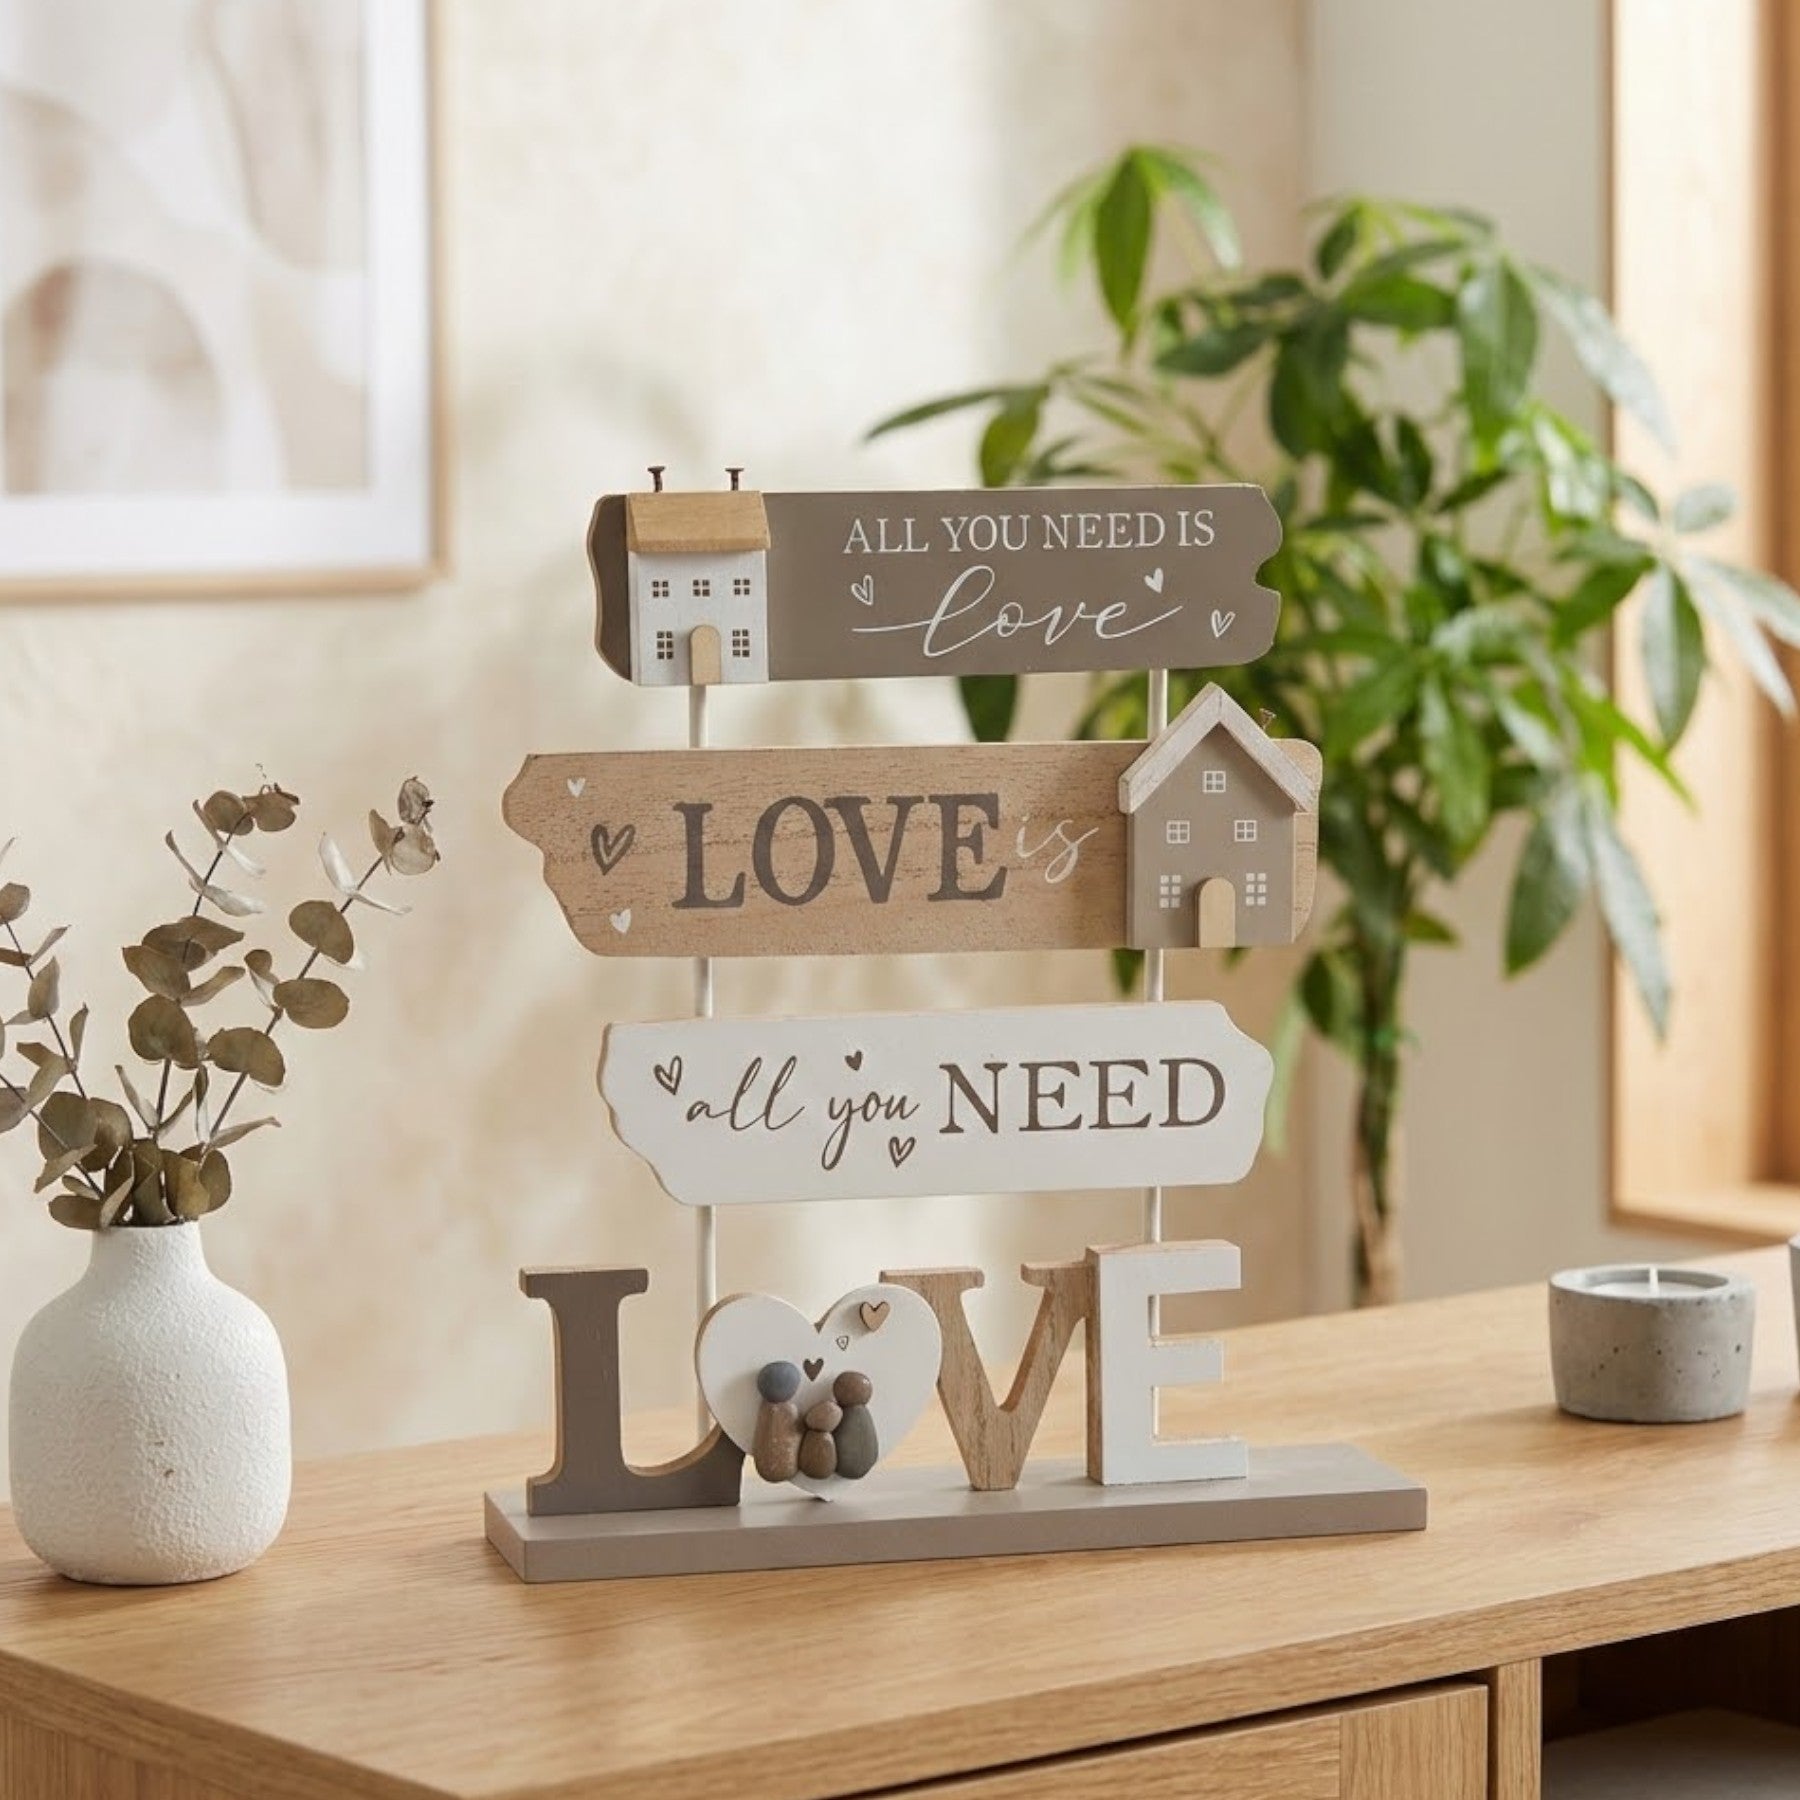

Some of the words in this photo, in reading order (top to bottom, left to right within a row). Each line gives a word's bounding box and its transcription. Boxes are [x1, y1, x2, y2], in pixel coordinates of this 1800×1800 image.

[843, 518, 929, 554] ALL
[941, 514, 1032, 551] YOU
[1043, 512, 1167, 549] NEED
[1175, 509, 1217, 547] IS
[851, 564, 1184, 658] love
[671, 792, 1008, 910] LOVE
[1015, 812, 1100, 884] is
[685, 1054, 805, 1131] all
[820, 1091, 921, 1171] you
[938, 1056, 1228, 1136] NEED
